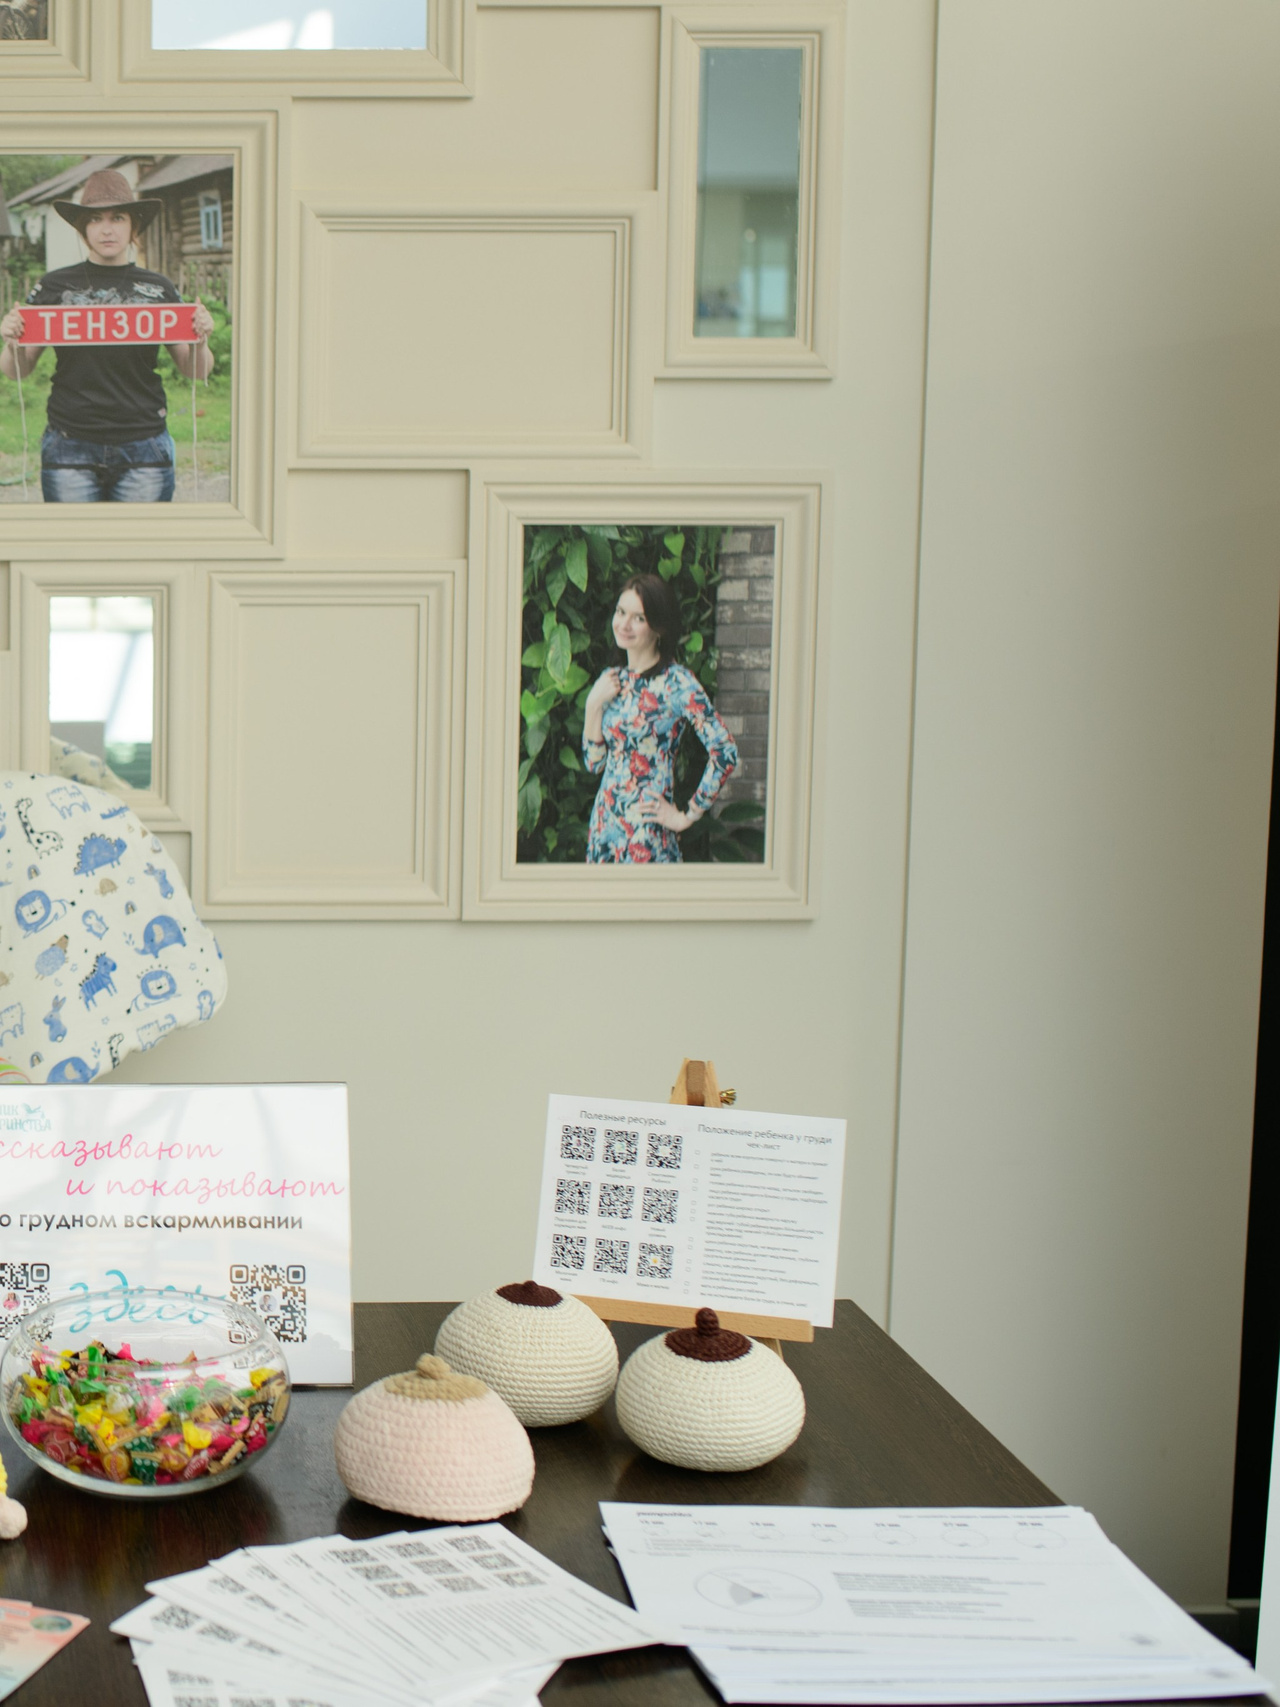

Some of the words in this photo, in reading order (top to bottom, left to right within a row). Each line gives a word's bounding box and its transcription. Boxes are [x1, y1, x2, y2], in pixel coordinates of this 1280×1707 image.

[38, 310, 178, 341] ТЕНЗОР
[580, 1110, 626, 1122] Полезные
[627, 1115, 667, 1127] ресурсы
[697, 1123, 753, 1138] Положение
[754, 1129, 795, 1141] ребенка
[803, 1134, 833, 1145] груди
[66, 1178, 96, 1197] и
[106, 1171, 346, 1205] показывают
[19, 1212, 118, 1231] грудном
[124, 1212, 304, 1233] вскармливании
